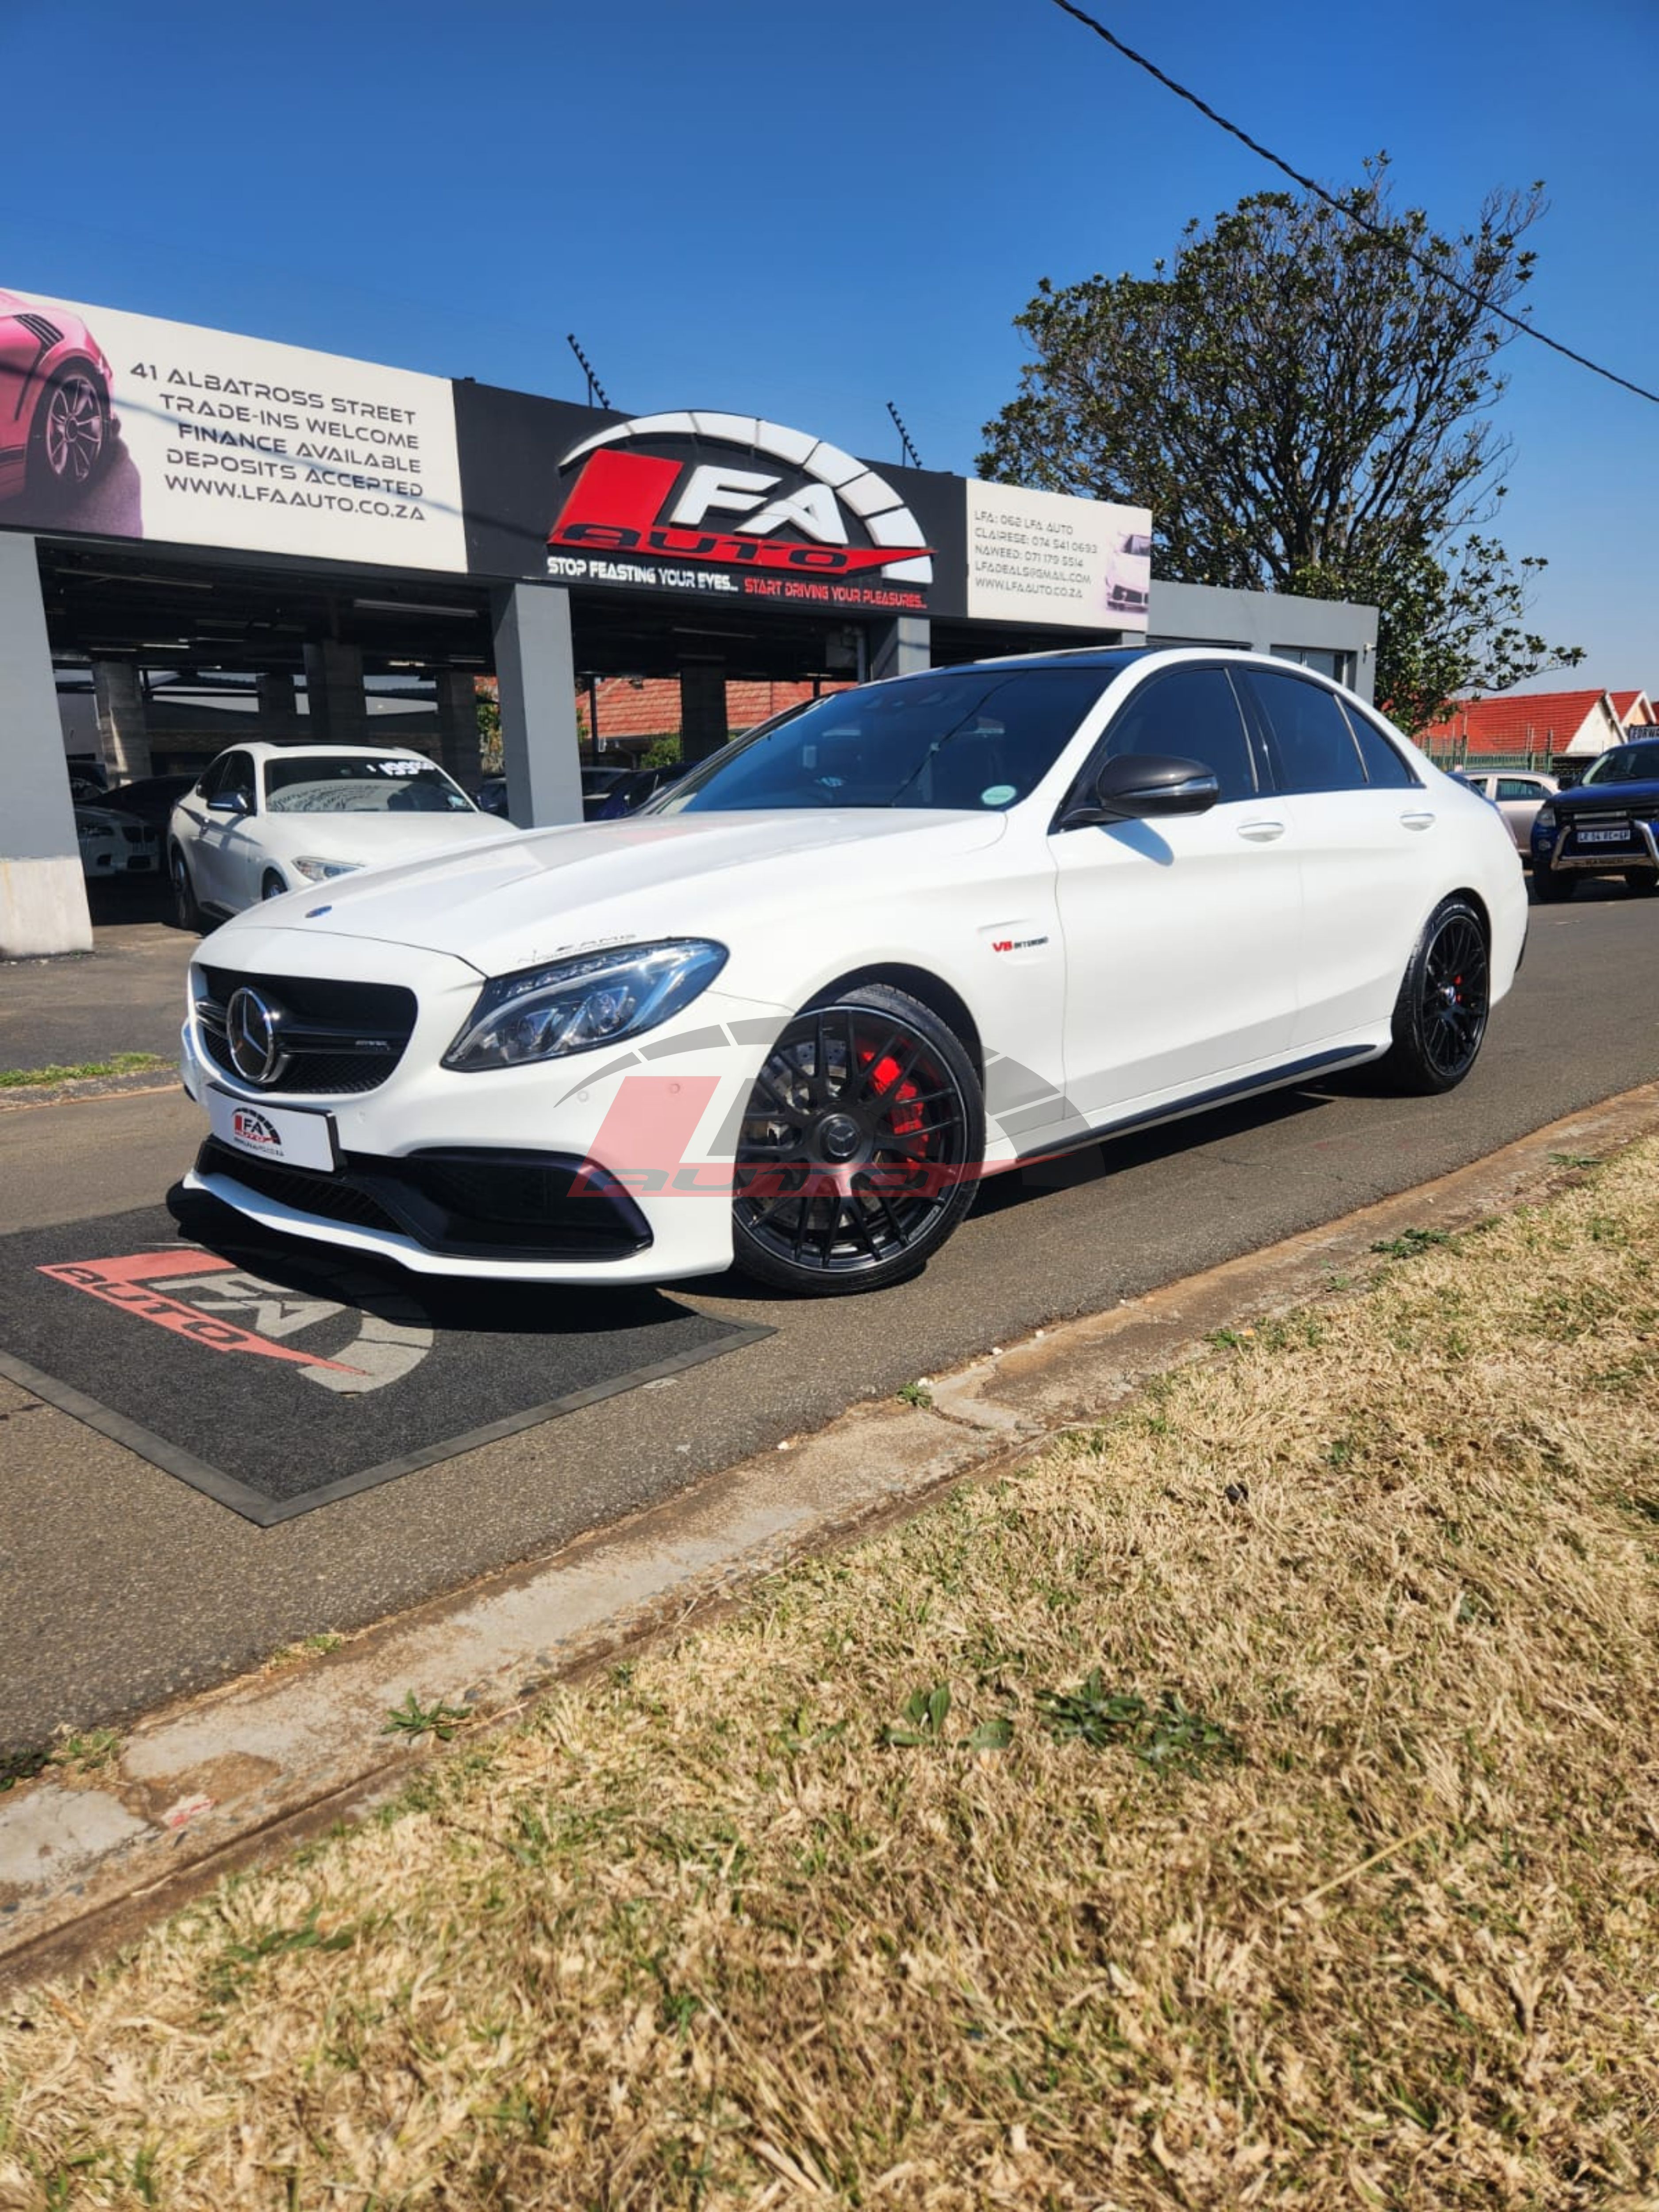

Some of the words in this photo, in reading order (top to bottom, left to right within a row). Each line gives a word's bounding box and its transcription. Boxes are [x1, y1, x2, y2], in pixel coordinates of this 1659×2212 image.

[130, 362, 157, 380] 41
[167, 368, 324, 409] ALBATROSS
[331, 397, 416, 425] STREET
[159, 393, 300, 429] TRADE-INS
[306, 418, 419, 449] WELCOME
[178, 423, 287, 454] FINANCE
[296, 442, 421, 473] AVAILABLE
[165, 474, 426, 521] WWW.LFAAUTO.CO.ZA
[166, 449, 296, 480] DEPOSITS
[304, 468, 423, 498] ACCEPTED
[562, 523, 849, 568] AUTO
[1046, 522, 1074, 535] AUTO
[547, 556, 587, 576] STOP
[589, 560, 657, 585] FEASTING
[658, 566, 696, 588] YOUR
[744, 579, 782, 597] START
[785, 582, 830, 600] DRIVING
[832, 585, 861, 603] YOUR
[53, 1266, 249, 1344] AUTO
